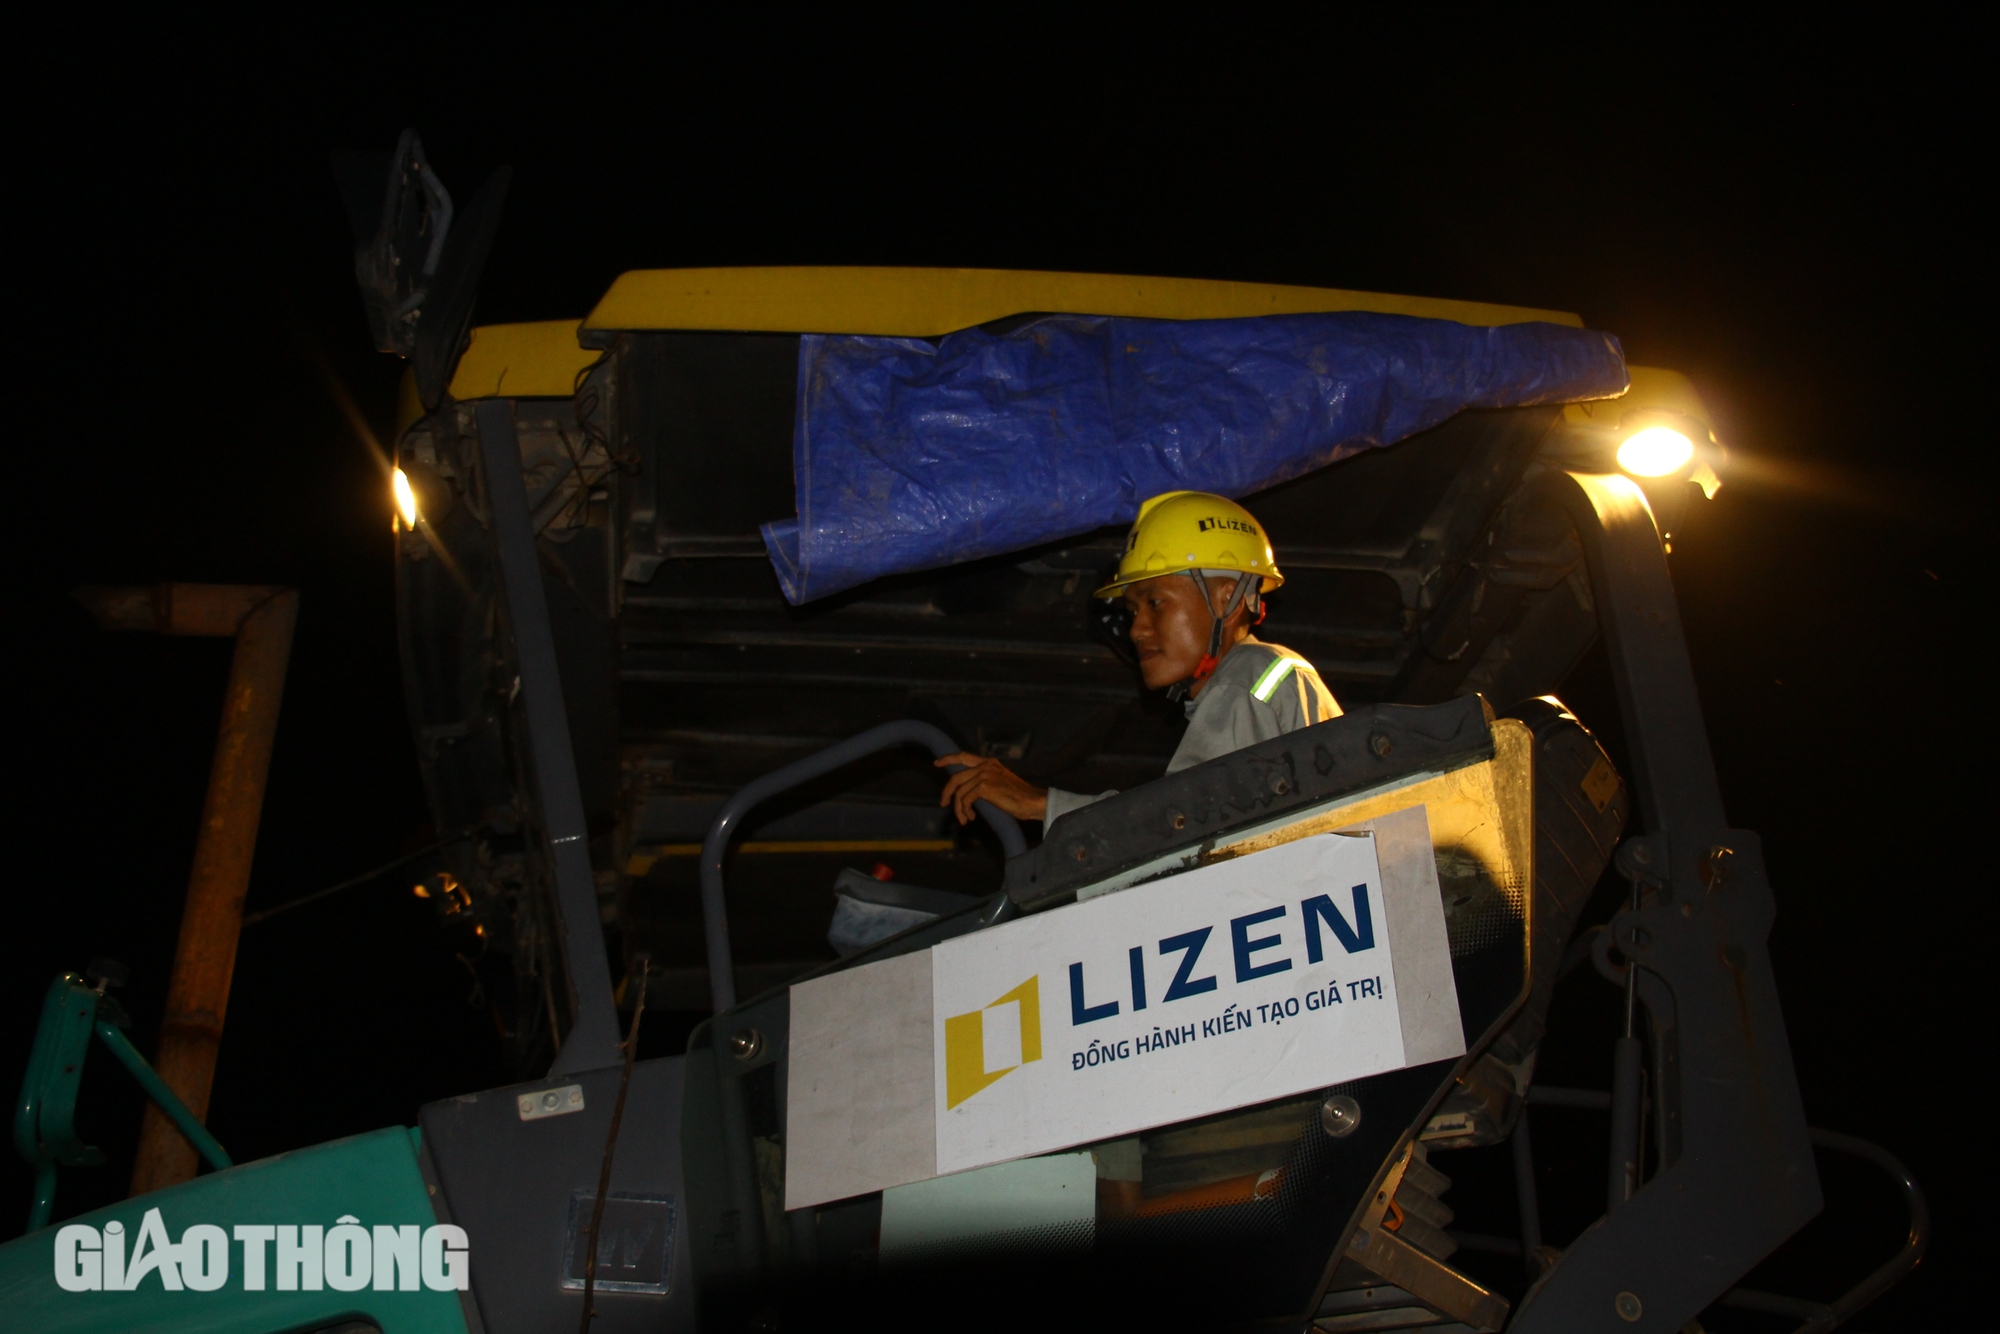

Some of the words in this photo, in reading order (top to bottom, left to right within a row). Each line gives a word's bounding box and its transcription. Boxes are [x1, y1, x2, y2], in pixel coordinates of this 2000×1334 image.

[1217, 520, 1257, 536] LIZEN
[1069, 883, 1375, 1026] LIZEN
[1072, 1039, 1130, 1071] ĐỒNG
[1136, 1023, 1196, 1055] HÀNH
[1202, 1003, 1252, 1038] KIẾN
[1256, 997, 1299, 1025] TẠO
[1305, 980, 1342, 1011] GIÁ
[1346, 976, 1383, 1000] TRỊ
